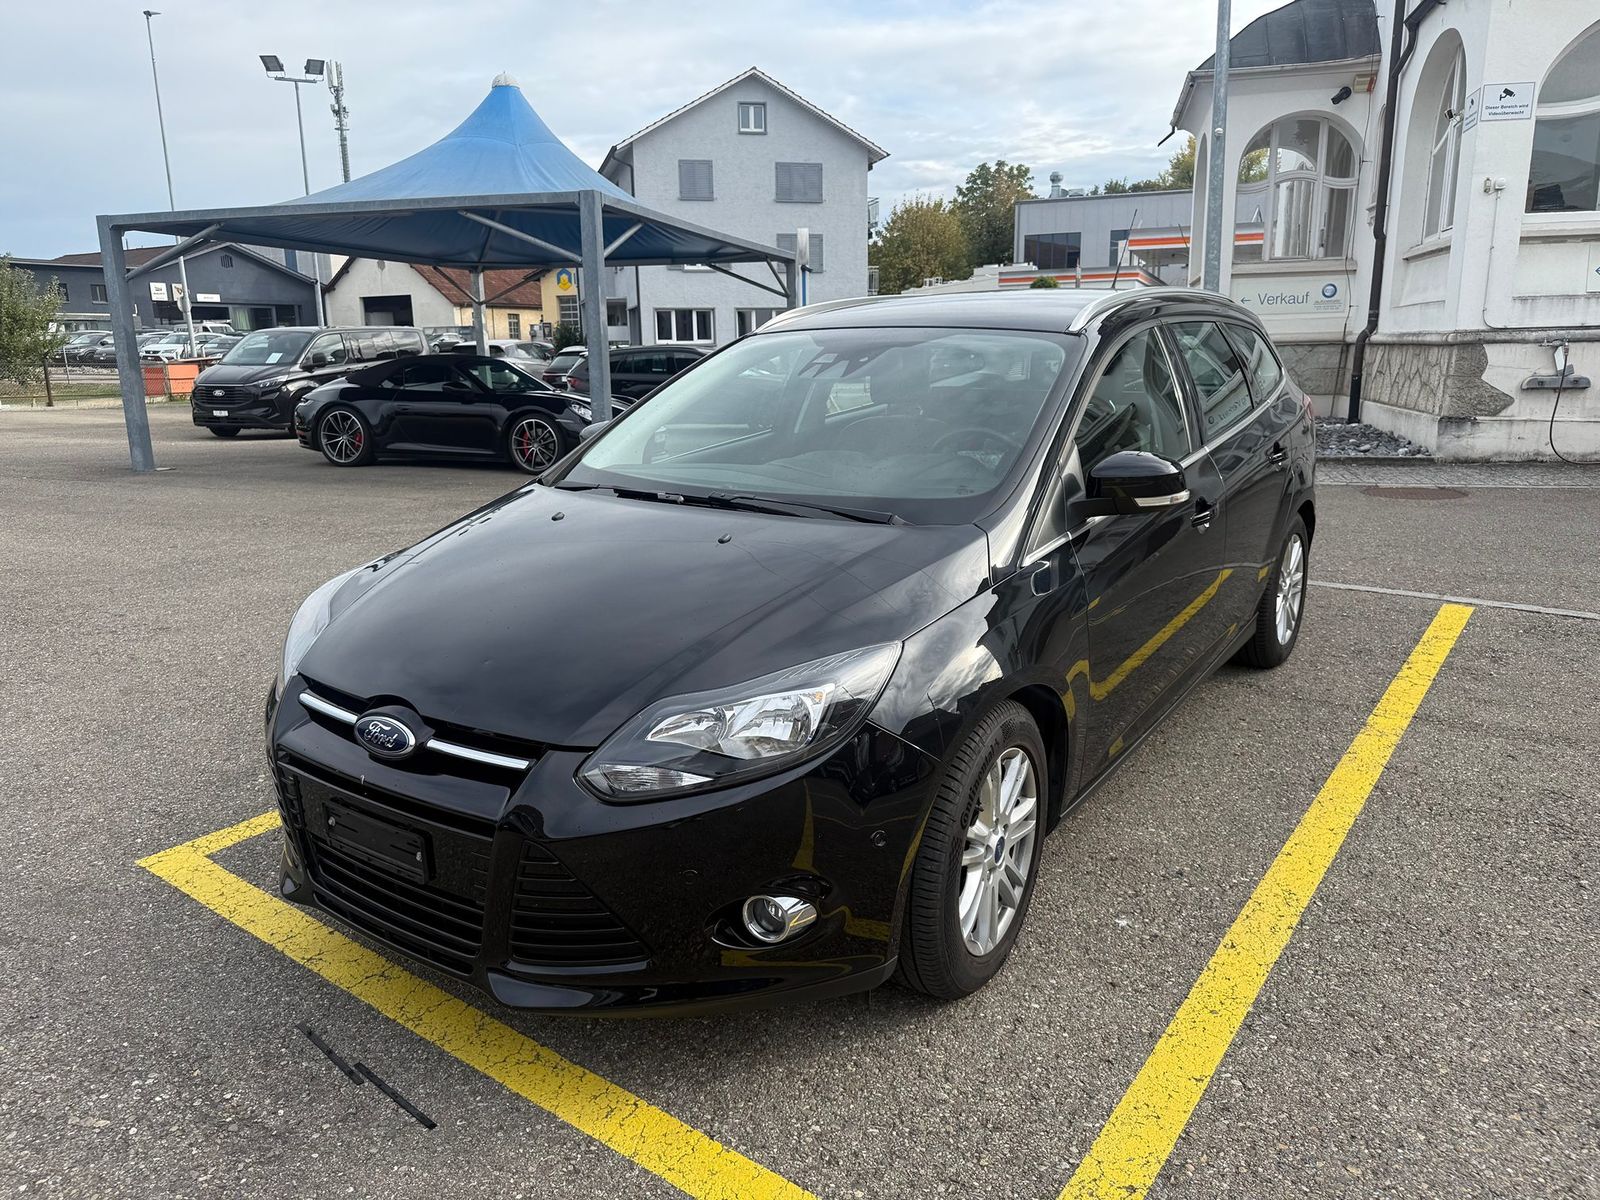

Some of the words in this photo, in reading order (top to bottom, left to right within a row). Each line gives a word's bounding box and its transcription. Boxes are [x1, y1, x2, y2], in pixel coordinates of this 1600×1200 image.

[1257, 291, 1310, 305] Verkauf
[364, 721, 398, 748] Ford
[960, 744, 995, 831] Continental
